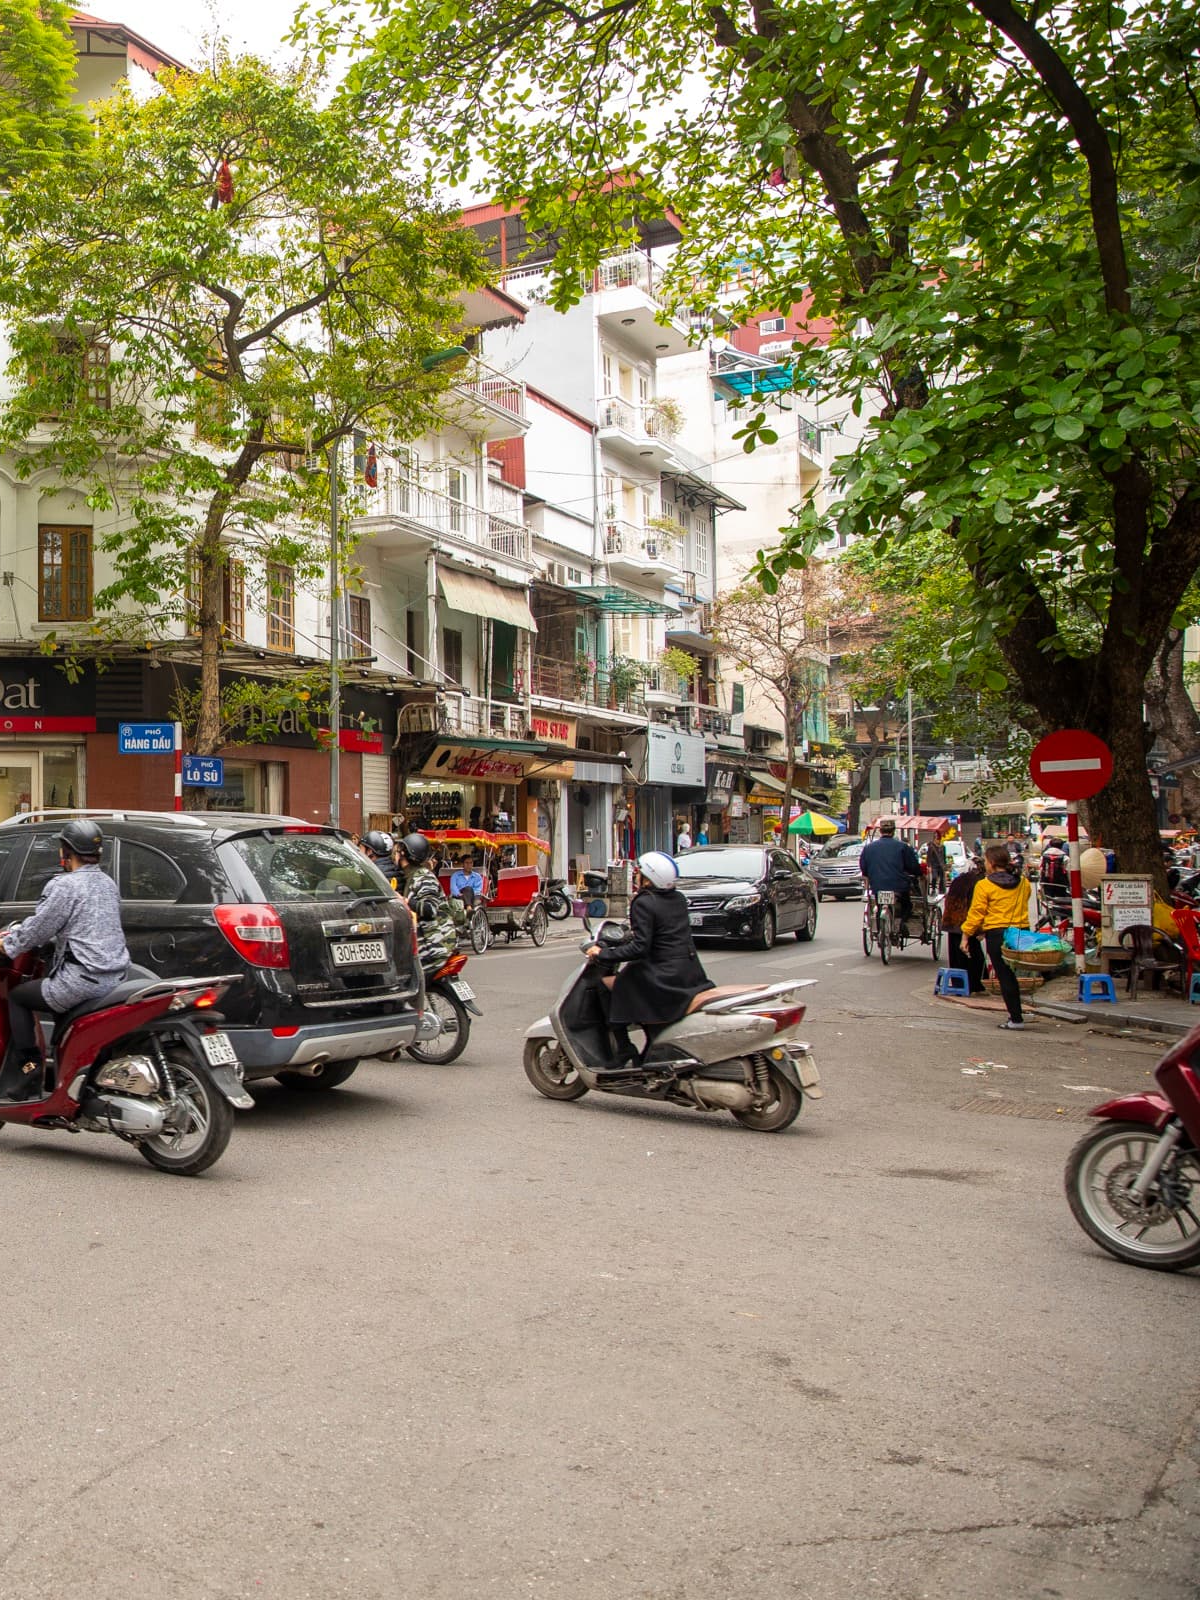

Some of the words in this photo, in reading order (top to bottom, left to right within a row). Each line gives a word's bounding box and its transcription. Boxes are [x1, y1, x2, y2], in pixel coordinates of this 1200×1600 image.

[145, 727, 162, 736] PHỐ
[124, 736, 150, 750] HÀNG
[336, 943, 383, 961] 30H-5668
